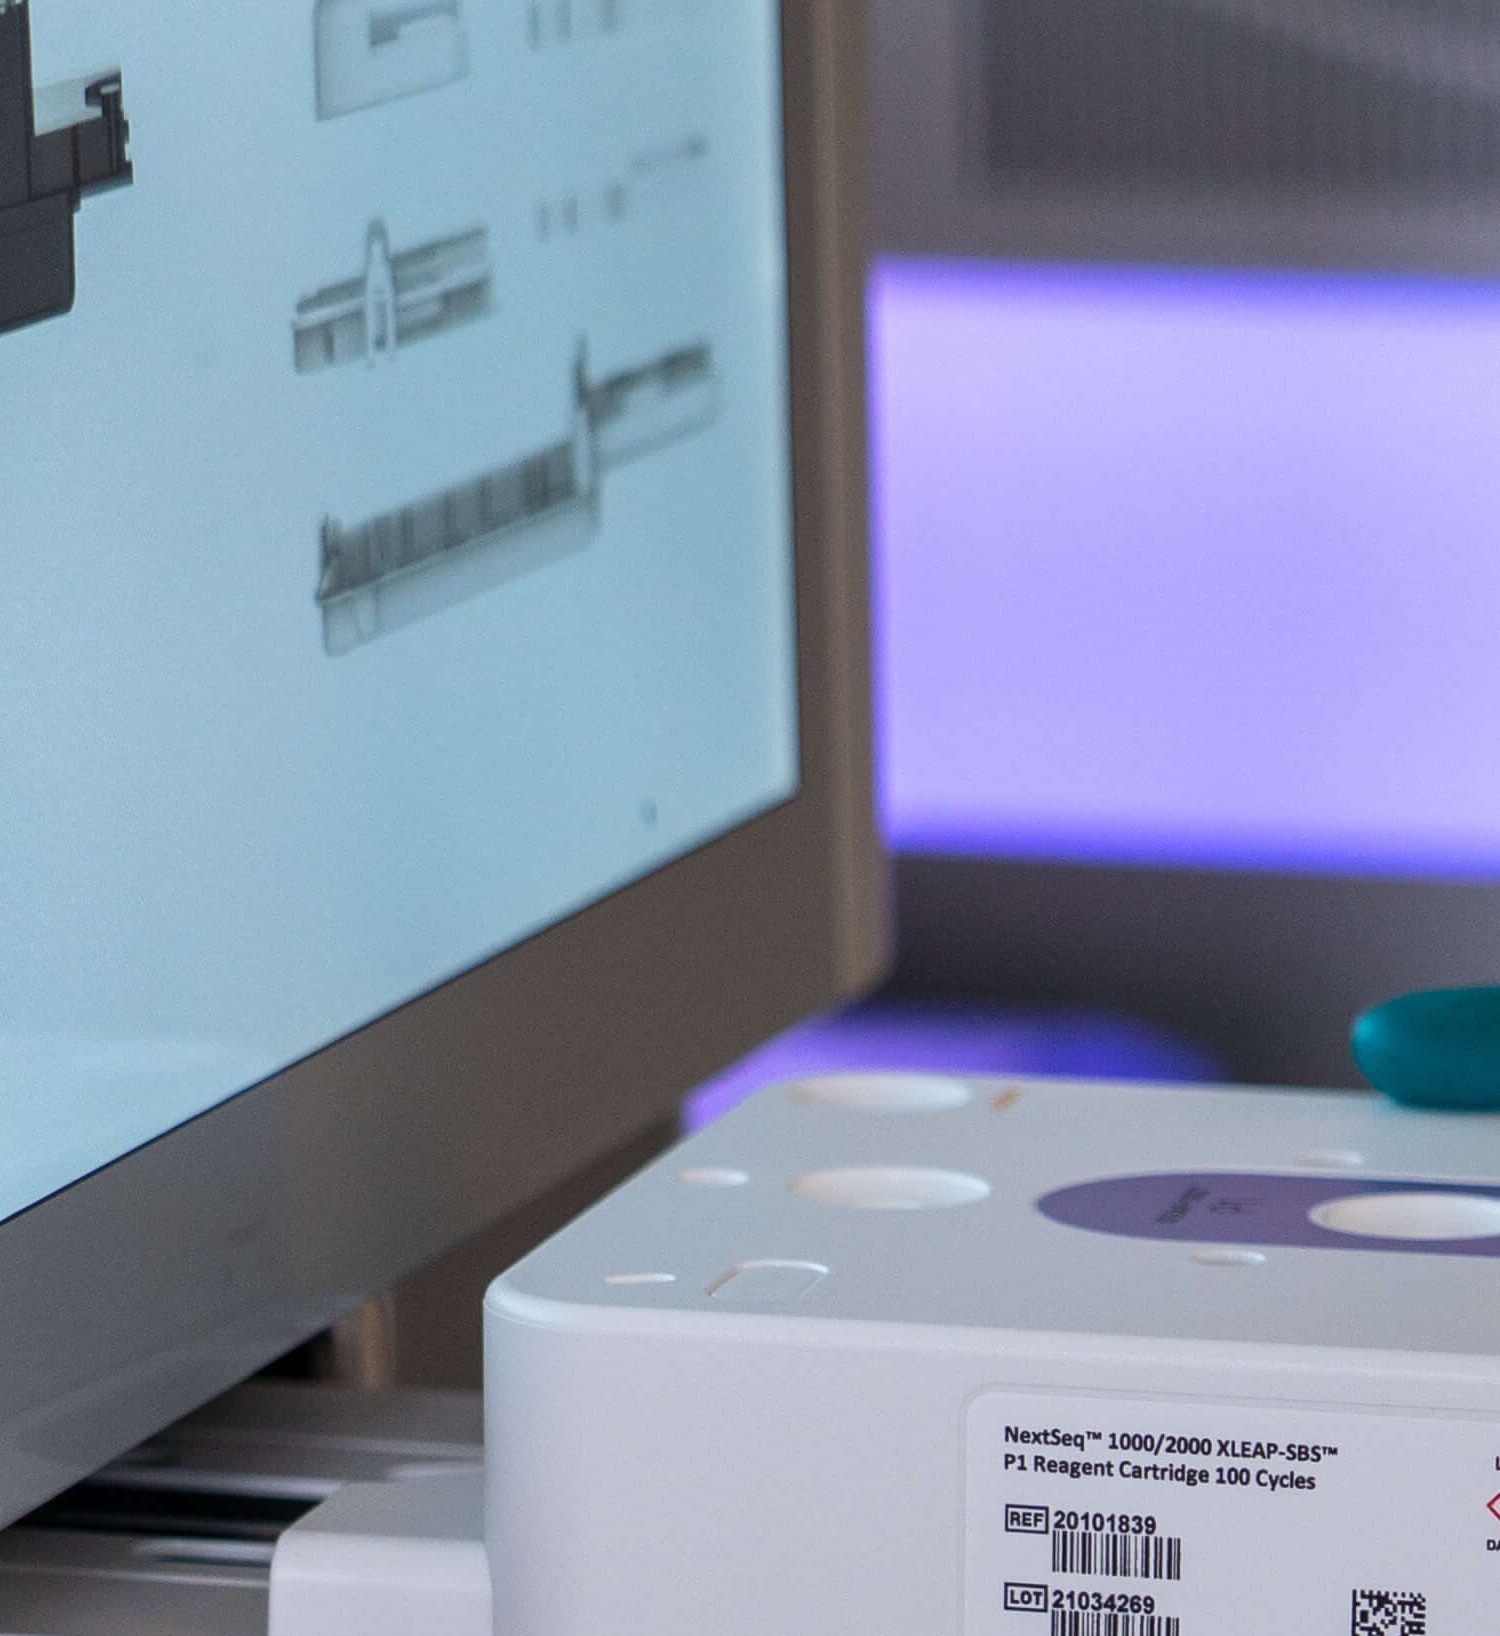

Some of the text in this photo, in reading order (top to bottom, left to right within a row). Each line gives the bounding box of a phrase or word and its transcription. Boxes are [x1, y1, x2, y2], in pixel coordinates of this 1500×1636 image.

[1107, 1431, 1212, 1456] 1000/2000
[1003, 1452, 1316, 1492] P1 Reagent Cartridge 100 Cycles
[1009, 1507, 1157, 1535] REF 20101839
[1007, 1586, 1155, 1614] LOT 21034269
